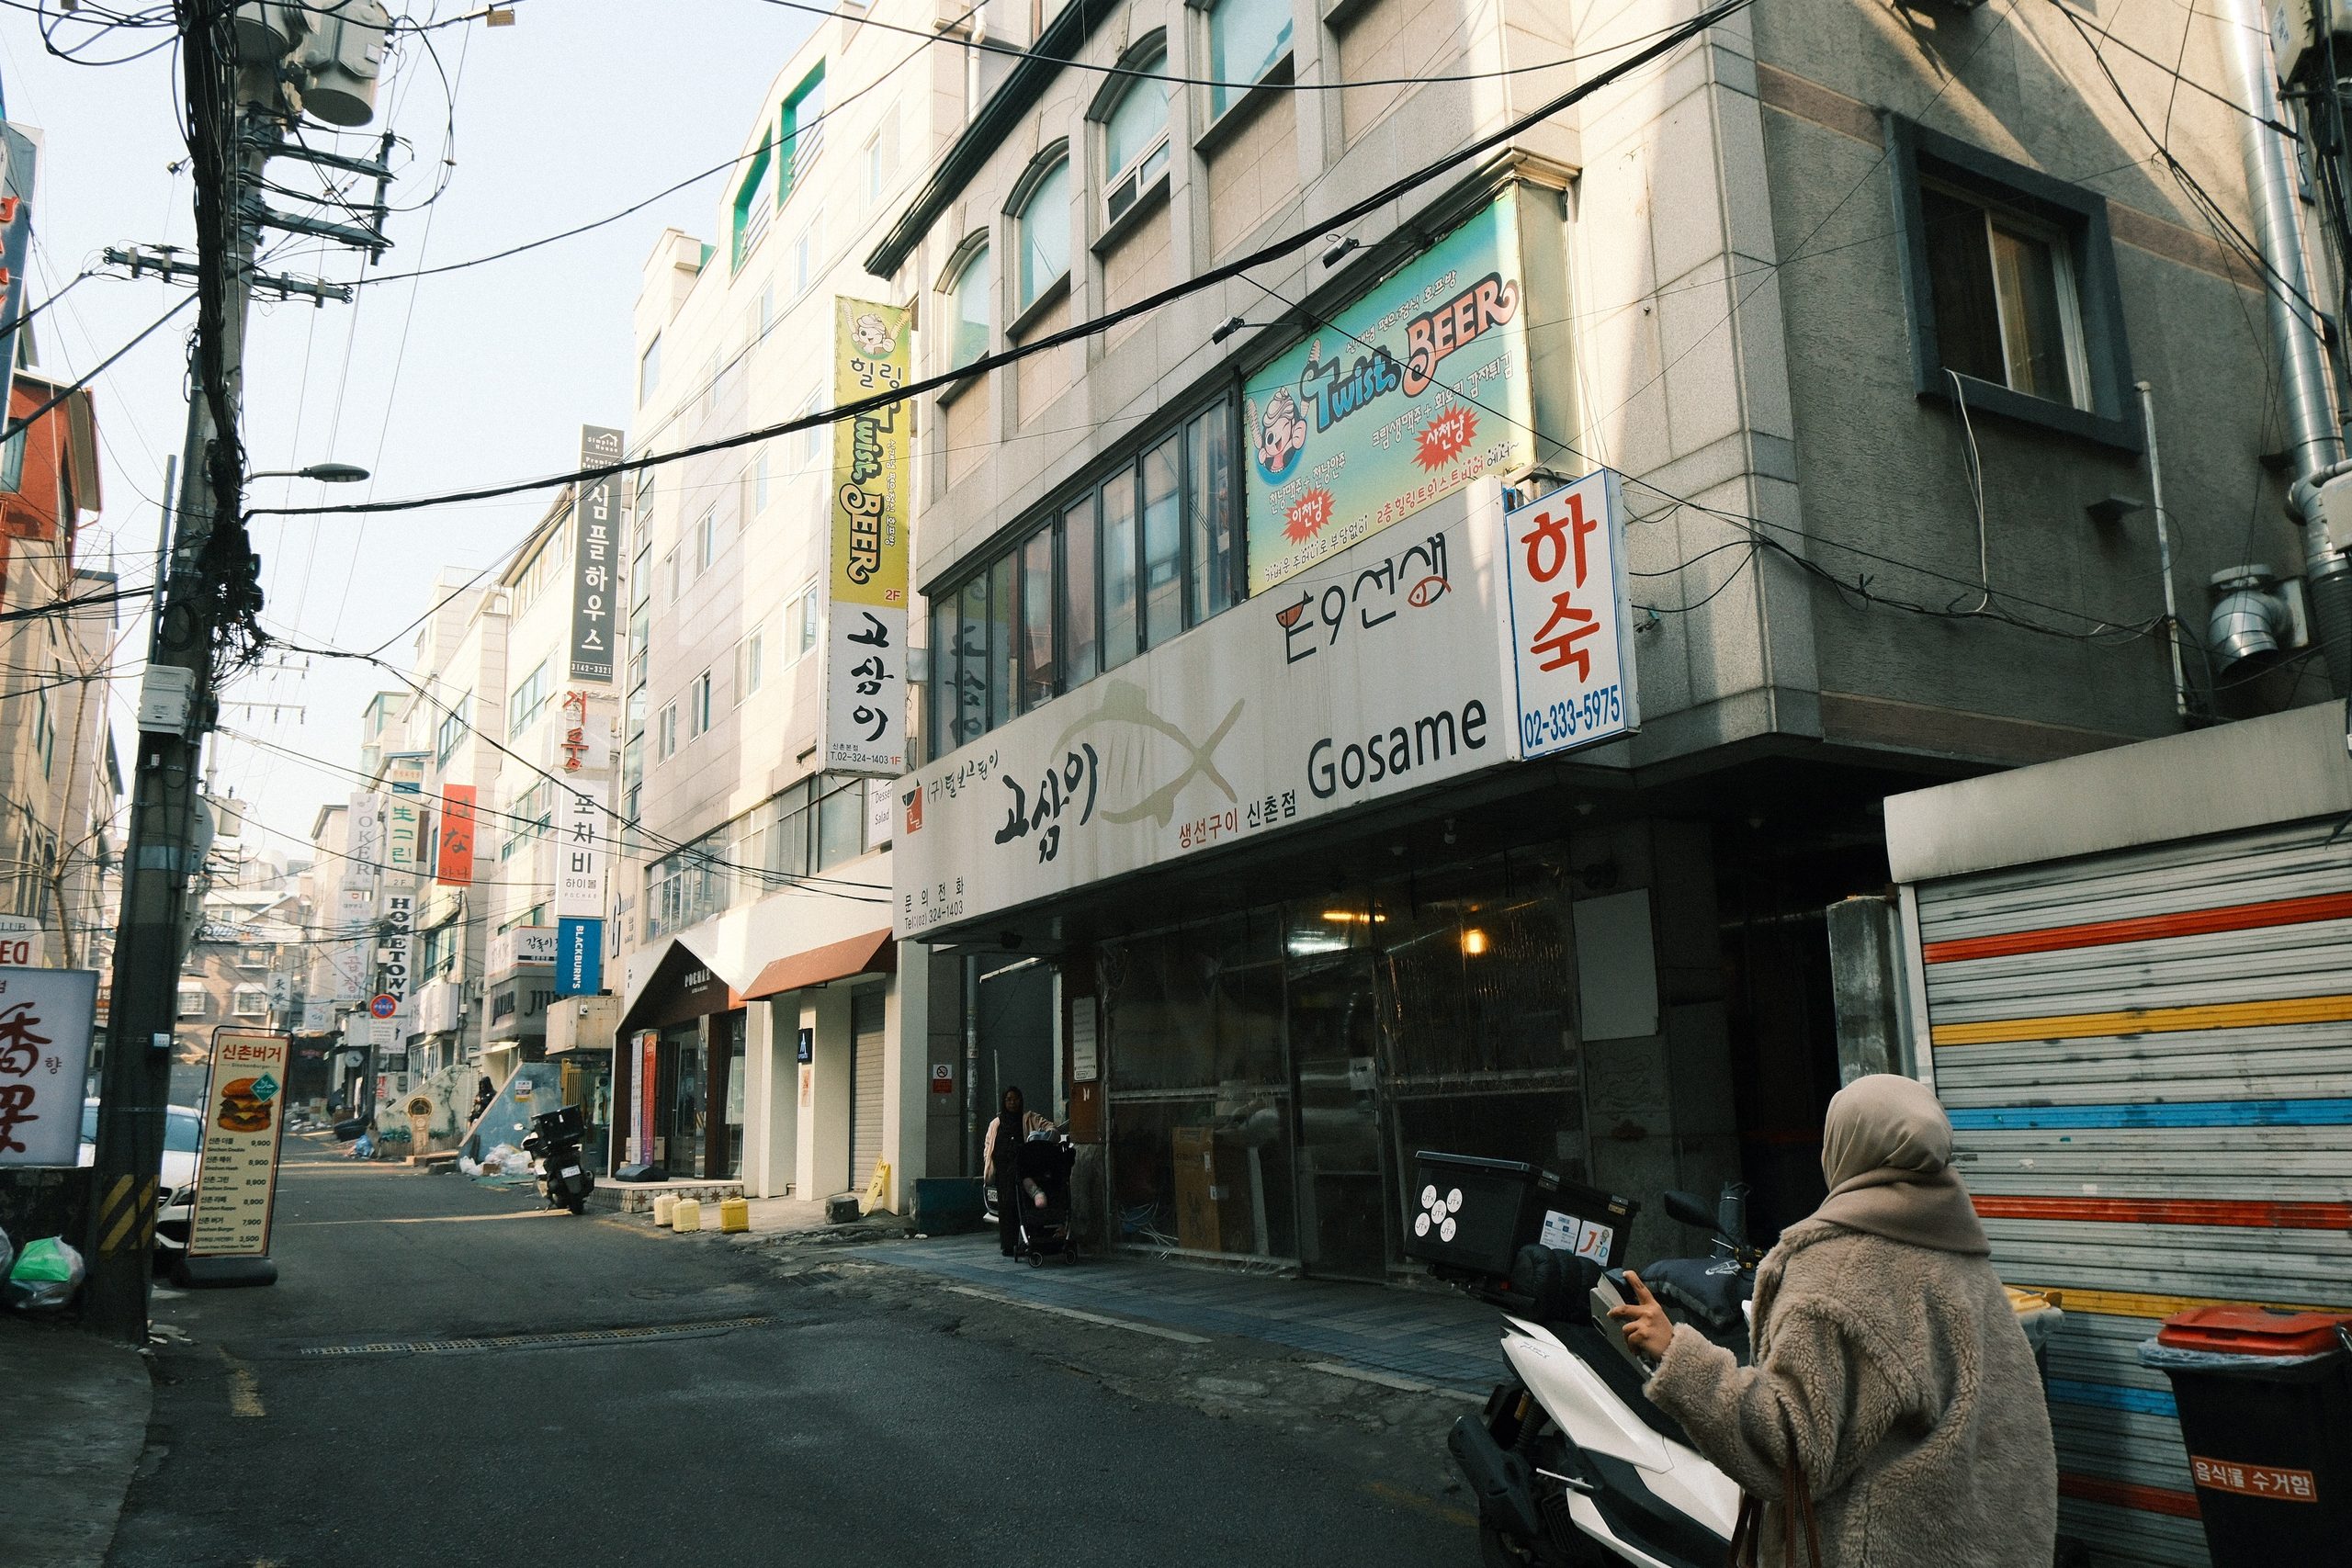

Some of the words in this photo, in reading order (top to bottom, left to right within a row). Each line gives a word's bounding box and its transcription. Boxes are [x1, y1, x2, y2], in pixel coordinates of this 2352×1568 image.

[1422, 270, 1457, 304] 호프방
[850, 357, 901, 389] 힐링
[1300, 344, 1402, 434] Twist
[1402, 272, 1521, 399] BEER
[1372, 405, 1423, 451] 크림생맥주
[1434, 379, 1464, 411] 회오리
[1466, 350, 1514, 400] 감자튀김
[1426, 413, 1465, 451] 사천냥
[1269, 477, 1302, 515] 천냥맥주
[1312, 451, 1346, 490] 천냥안주
[840, 483, 884, 585] BEER
[1292, 496, 1323, 528] 이천냥
[1330, 515, 1369, 550] 부담없이
[1376, 502, 1393, 525] 2층
[582, 483, 610, 651] 심플하우스
[1521, 492, 1601, 684] 하숙
[885, 589, 901, 602] 2F
[571, 662, 613, 675] 3142-3321
[846, 611, 895, 742] 고삼이
[1523, 683, 1622, 750] 02-333-5975
[831, 742, 859, 751] 신촌본점
[890, 756, 902, 766] 1F
[1307, 698, 1488, 800] Gosame
[443, 794, 471, 854] はな
[995, 742, 1099, 864] 고삼이
[1179, 807, 1238, 850] 생선구이
[1247, 789, 1297, 829] 신촌점
[571, 794, 595, 874] 포차비
[393, 878, 406, 886] 2F
[440, 865, 469, 880] 하나
[905, 875, 964, 913] 문의전화
[929, 899, 964, 924] 324-1403
[386, 897, 411, 1003] HOMETOWN
[572, 925, 584, 989] BLACKBURN'S
[44, 1056, 63, 1076] 향
[222, 1043, 282, 1063] 신촌버거
[2195, 1461, 2245, 1489] 음식물
[2252, 1471, 2312, 1496] 수거함
